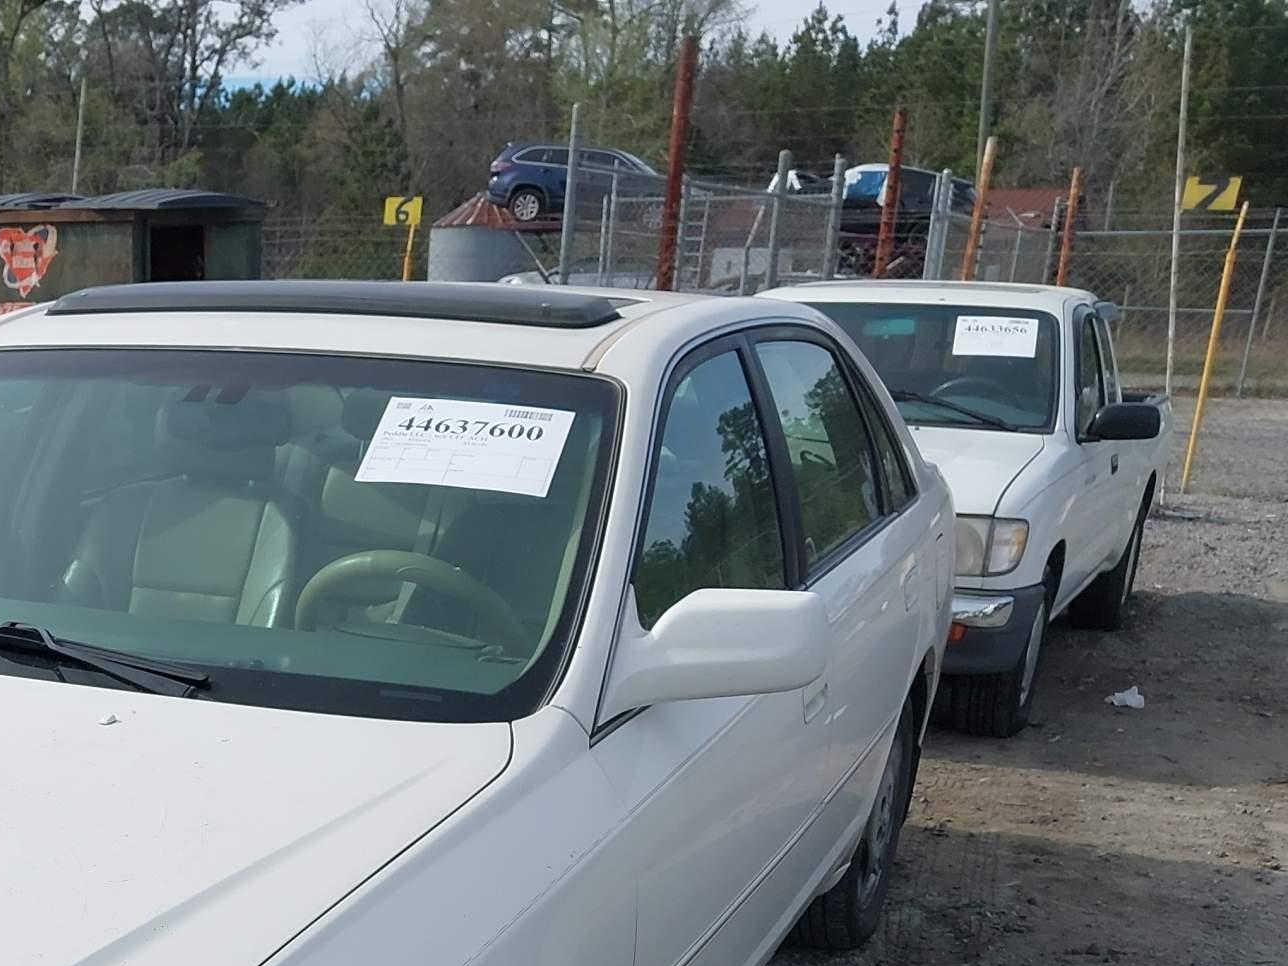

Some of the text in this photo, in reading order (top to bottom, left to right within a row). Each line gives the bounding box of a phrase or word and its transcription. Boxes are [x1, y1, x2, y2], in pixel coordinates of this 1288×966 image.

[1194, 175, 1230, 209] 7
[395, 196, 413, 225] 6
[398, 415, 544, 441] 44637600
